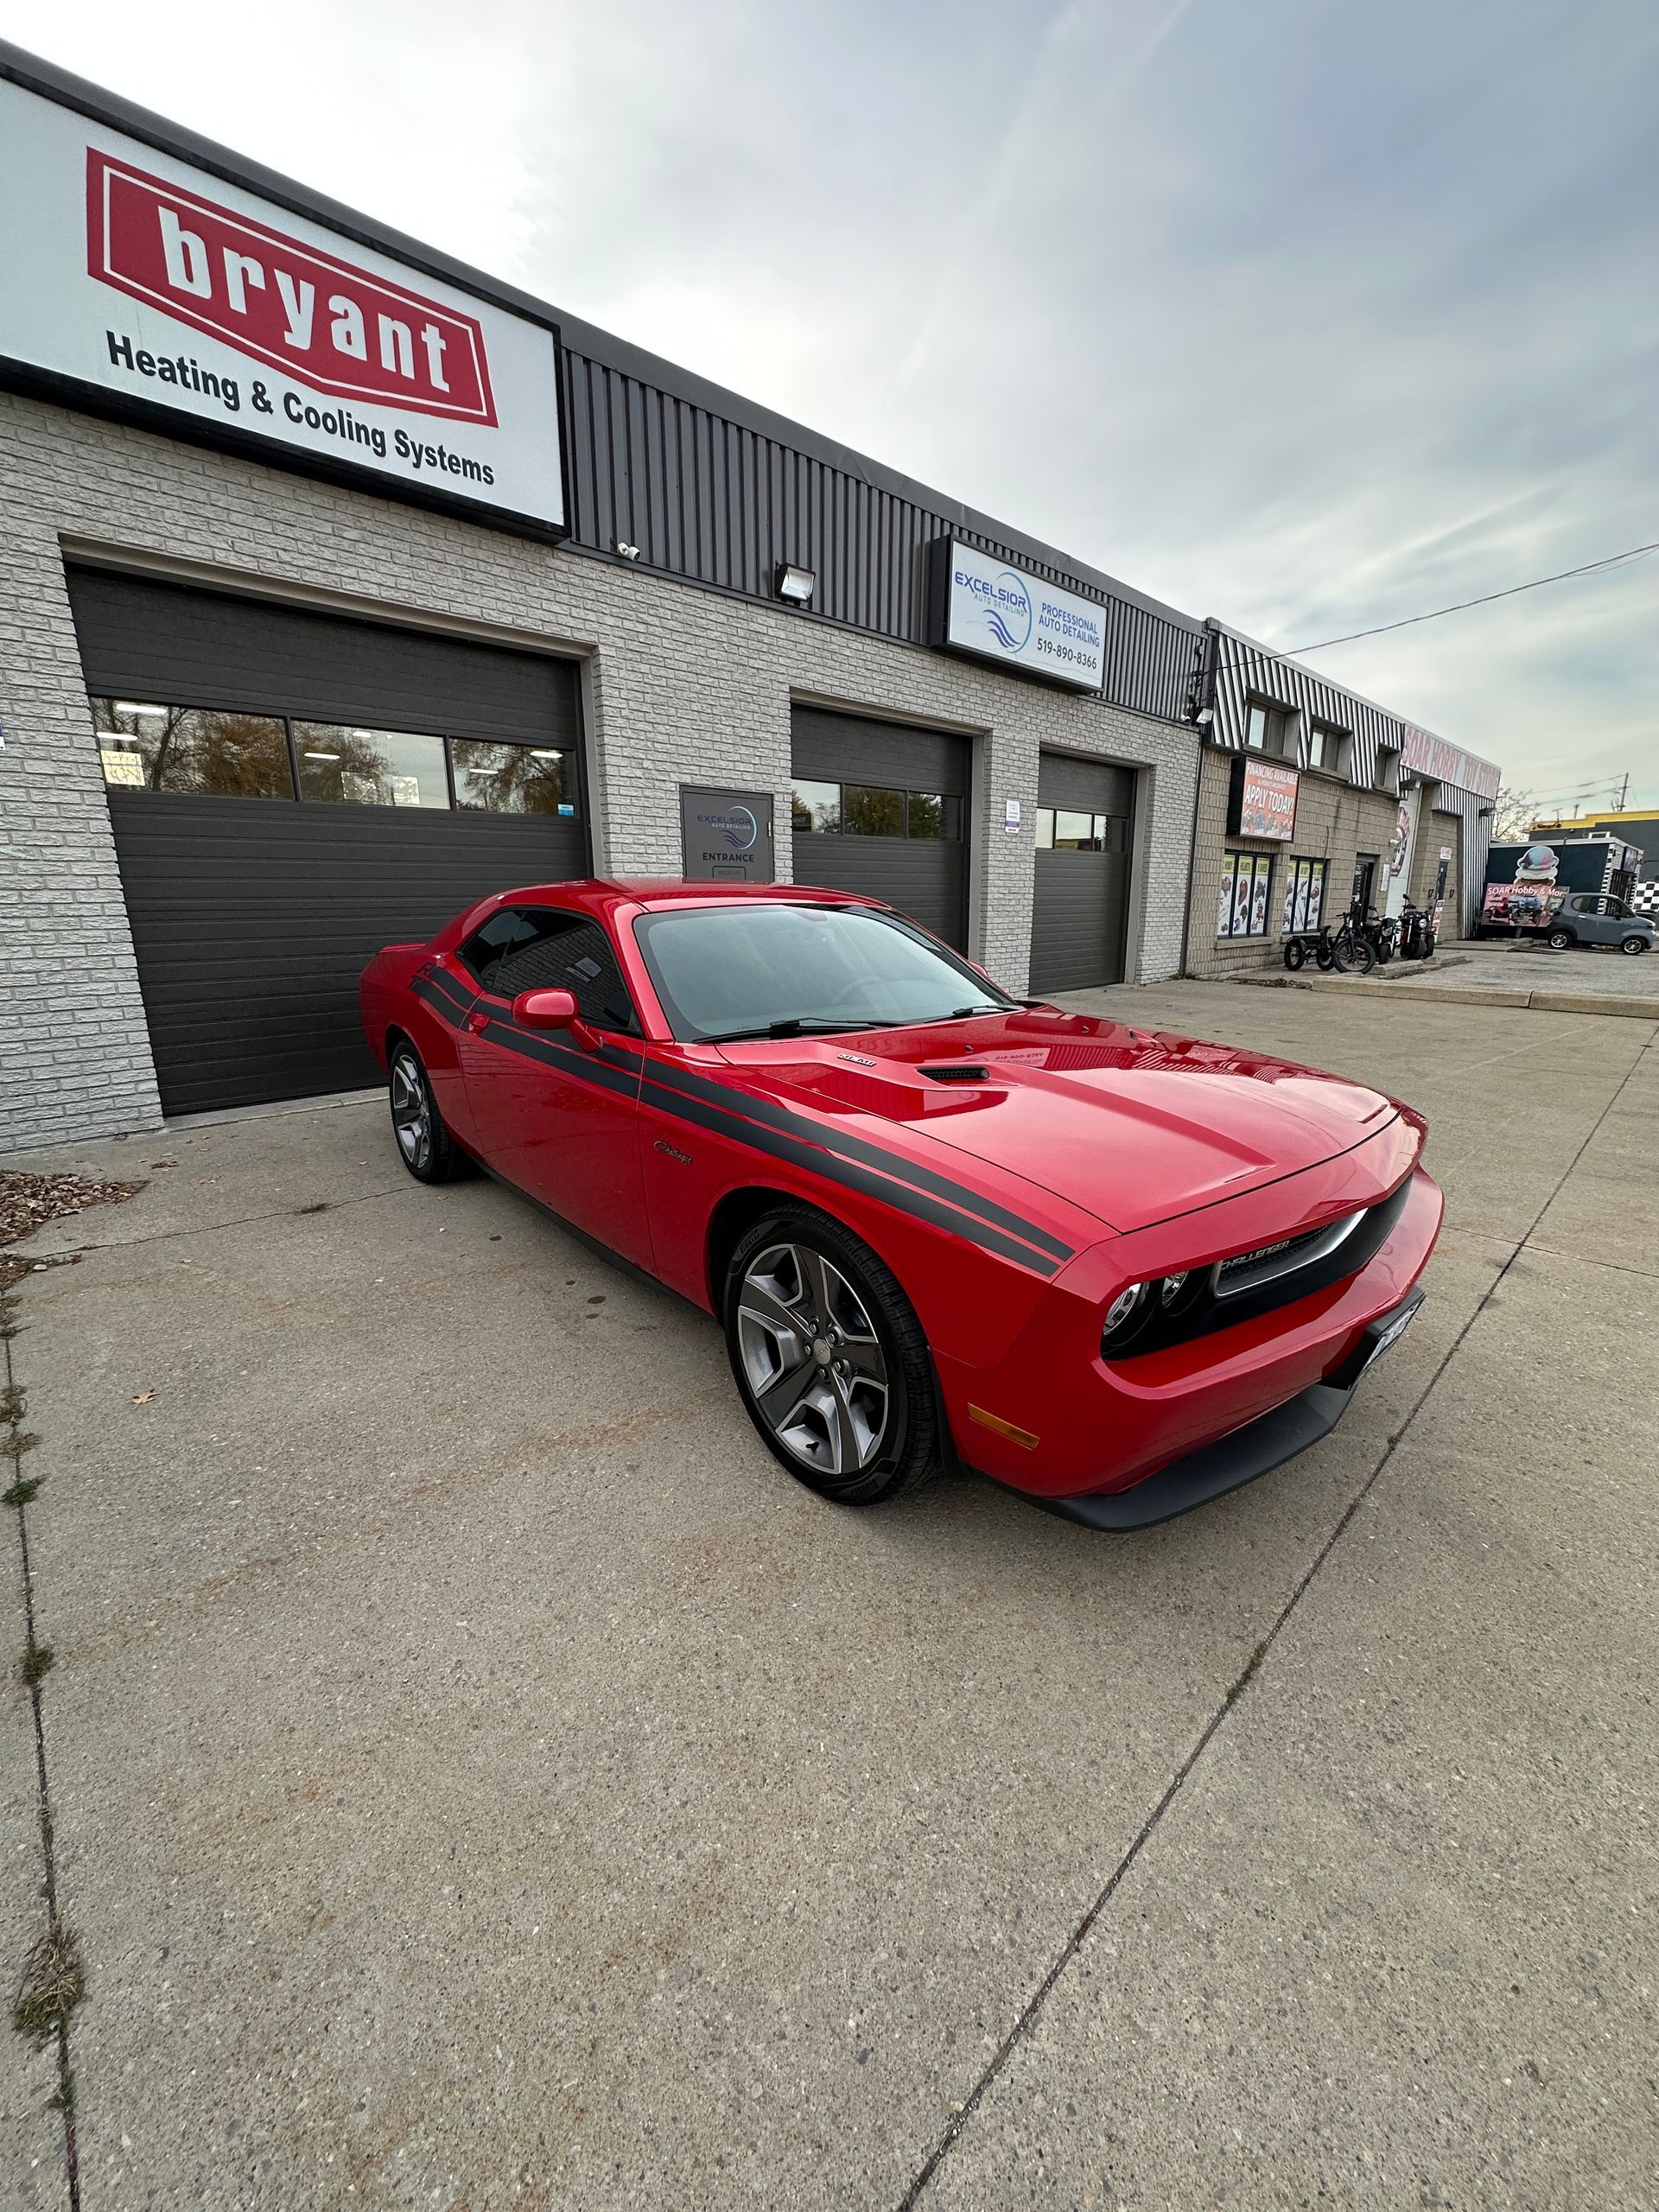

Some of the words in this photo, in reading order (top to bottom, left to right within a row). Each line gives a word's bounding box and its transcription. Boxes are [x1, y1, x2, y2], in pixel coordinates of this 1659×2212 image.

[157, 206, 449, 393] bryant
[106, 330, 240, 412] Heating
[251, 380, 274, 416] &
[283, 391, 386, 457] Cooling
[395, 429, 495, 486] Systems
[955, 571, 1027, 613] EXCELSIOR
[974, 593, 991, 605] AUTO
[994, 600, 1025, 617] DETAILING
[1039, 614, 1061, 632] AUTO
[1063, 624, 1100, 647] DETAILING
[1042, 602, 1098, 634] PROFESSIONAL
[1037, 638, 1097, 670] 519-890-8366
[1402, 726, 1432, 772] SOAR
[1429, 741, 1461, 783] HOBBY
[1244, 784, 1268, 808] APPLY
[1268, 791, 1295, 816] TODAY!
[697, 815, 753, 825] EXCELSIOR
[702, 852, 754, 862] ENTRANCE
[1487, 887, 1511, 895] SOAR
[1511, 886, 1539, 896] Hobby
[1220, 1240, 1290, 1270] CHALLENGER
